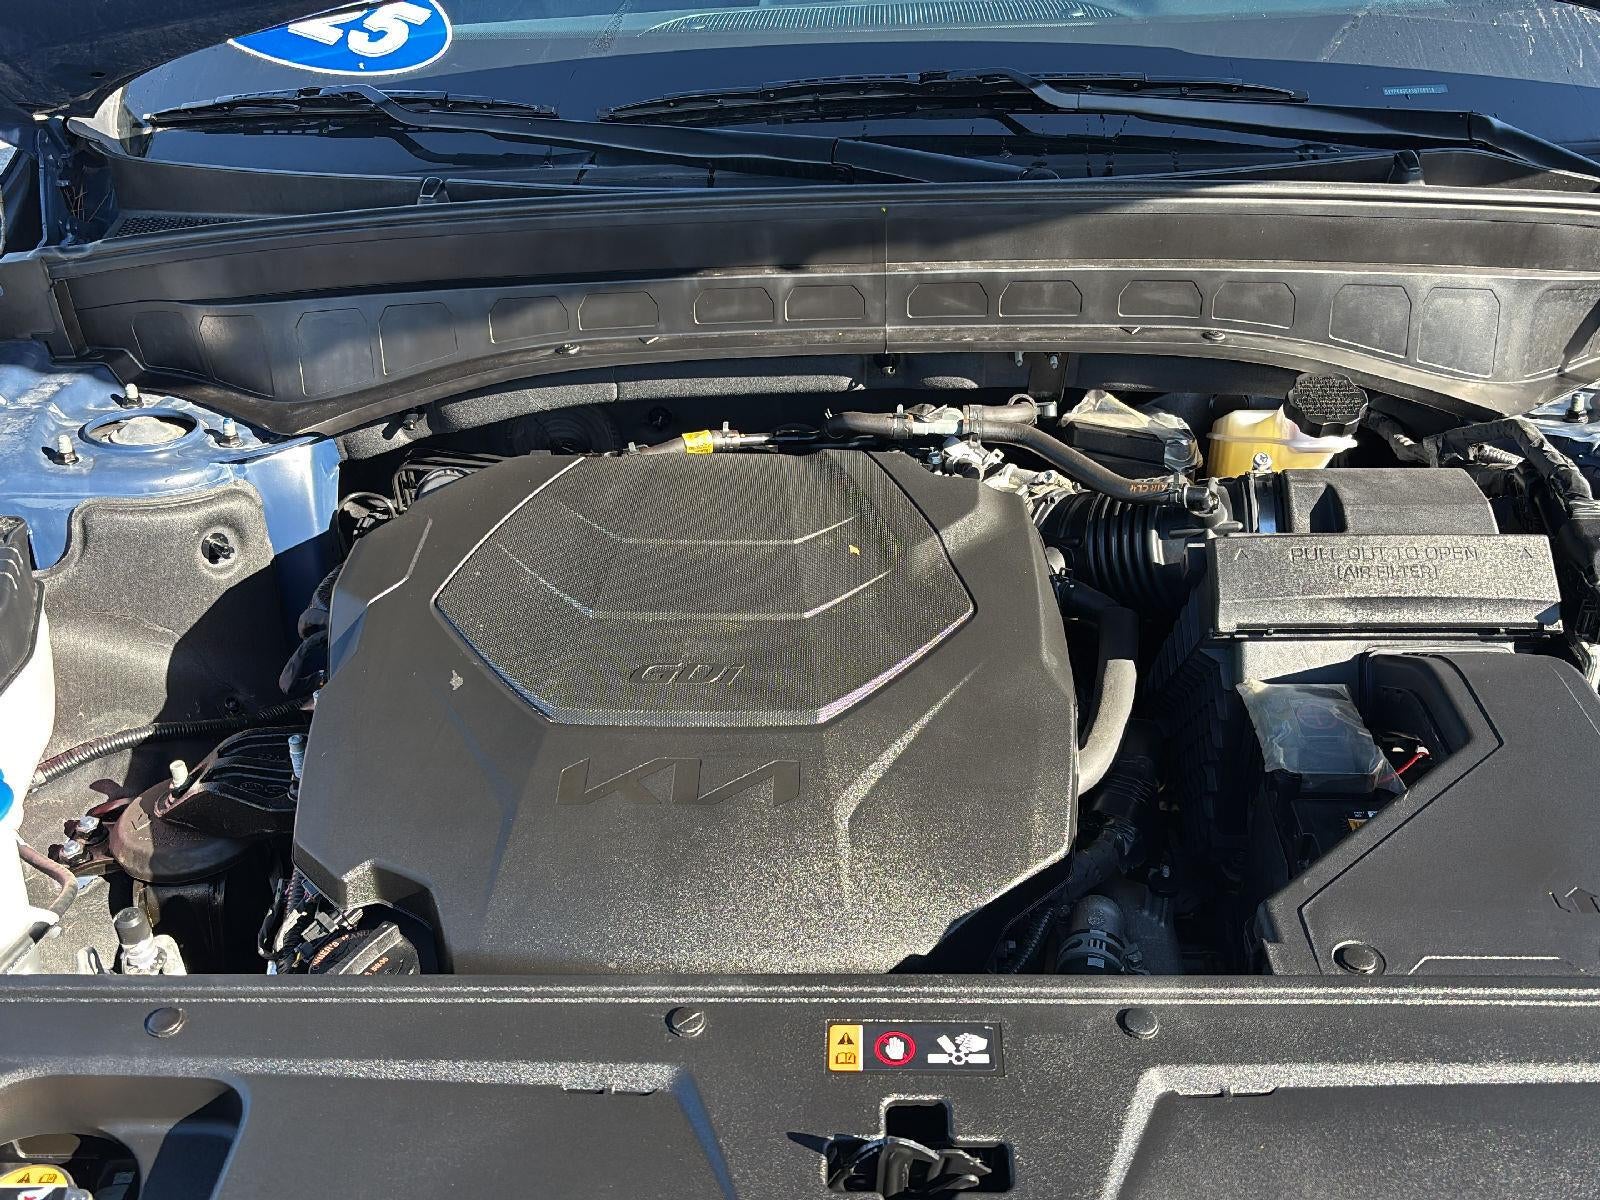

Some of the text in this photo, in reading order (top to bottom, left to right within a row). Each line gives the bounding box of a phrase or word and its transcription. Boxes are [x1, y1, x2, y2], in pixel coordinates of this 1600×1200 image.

[1290, 546, 1479, 563] PULL OUT TO OPEN
[1336, 564, 1440, 581] (AIR FILTER)
[556, 757, 801, 805] KIA
